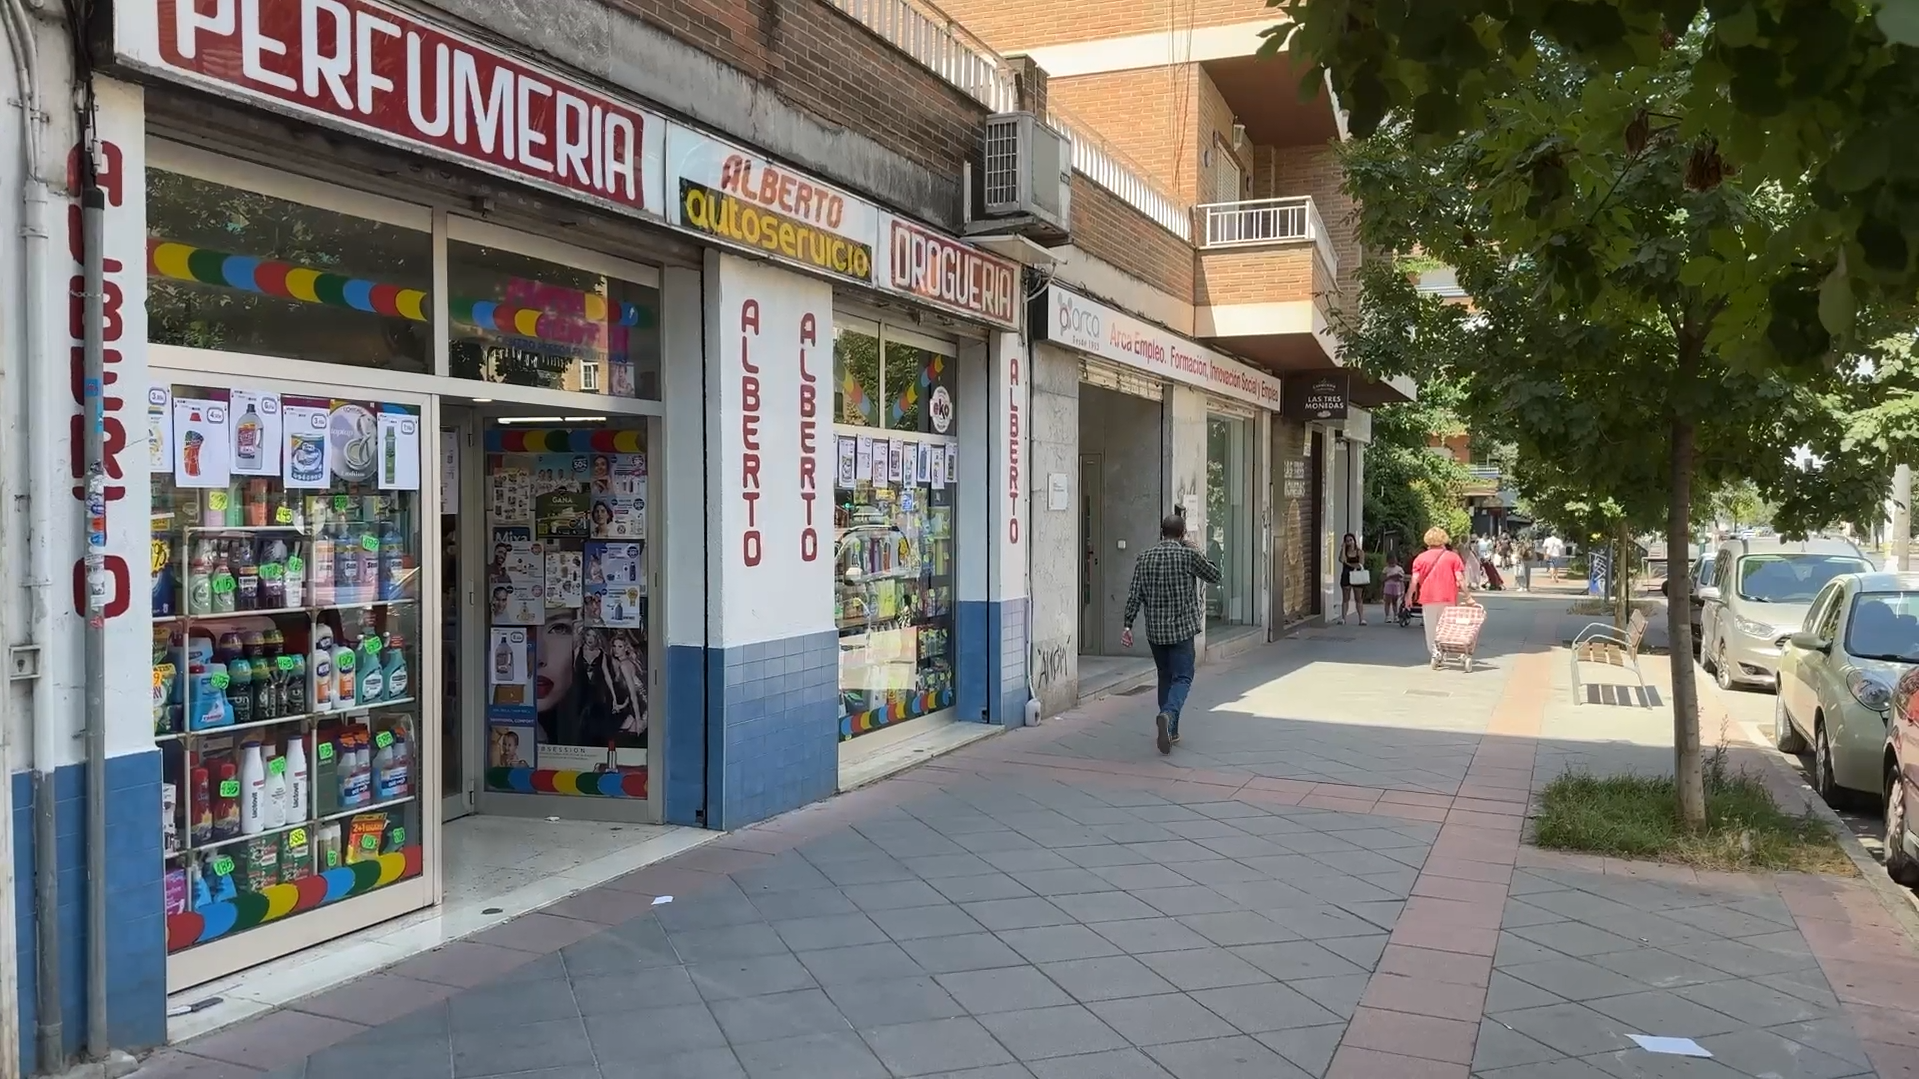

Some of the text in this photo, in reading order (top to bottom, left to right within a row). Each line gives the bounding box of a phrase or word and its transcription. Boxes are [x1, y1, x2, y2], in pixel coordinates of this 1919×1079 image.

[176, 0, 637, 202] PERFUMERIA
[721, 153, 844, 229] ALBERTO
[895, 225, 1014, 321] DROGUERIA
[1071, 307, 1101, 339] arca
[1110, 326, 1132, 352] Arca
[1134, 333, 1167, 364] Empleo.
[1170, 345, 1209, 382] Formación,
[1210, 358, 1241, 390] Innovación
[1241, 371, 1257, 396] Social
[1261, 380, 1279, 403] Empleo
[1323, 395, 1341, 403] TRES
[741, 298, 762, 567] ALBERTO
[800, 312, 818, 562] ALBERTO
[933, 398, 950, 420] eko
[1305, 402, 1344, 410] MONEDAS
[1009, 358, 1019, 544] ALBERTO
[552, 496, 573, 504] GANA
